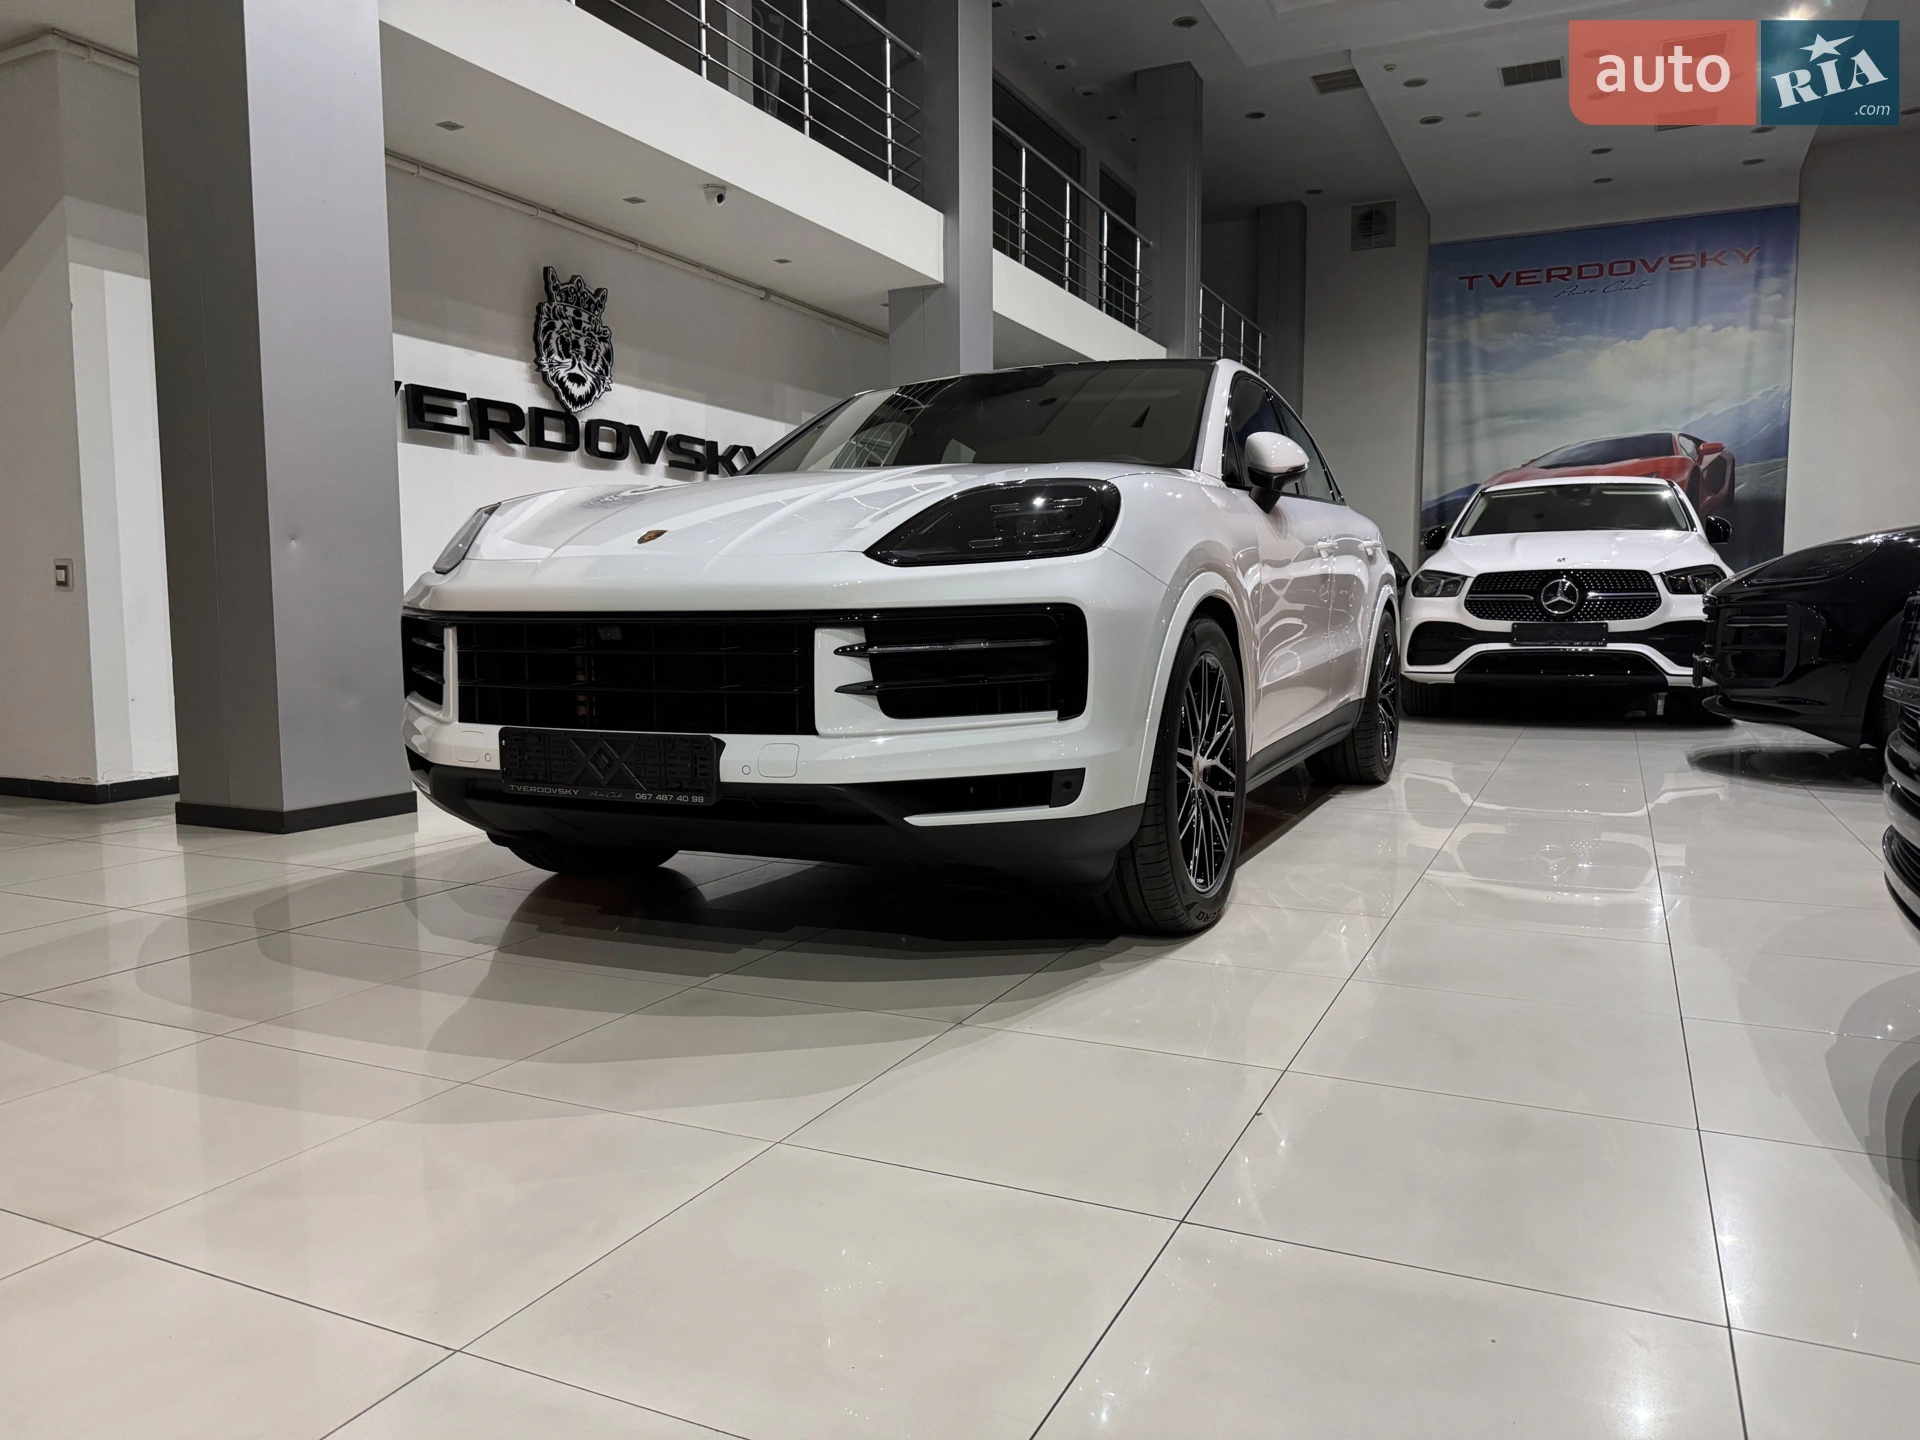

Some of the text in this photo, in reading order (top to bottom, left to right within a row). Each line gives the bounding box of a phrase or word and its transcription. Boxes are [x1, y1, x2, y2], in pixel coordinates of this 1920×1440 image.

[1458, 246, 1760, 292] TVERDOVSKY
[1553, 279, 1652, 298] Auto Club
[394, 380, 757, 477] ERDOVSK
[508, 784, 580, 796] TVERDOVSKY
[635, 792, 653, 801] 067
[655, 794, 674, 802] 487
